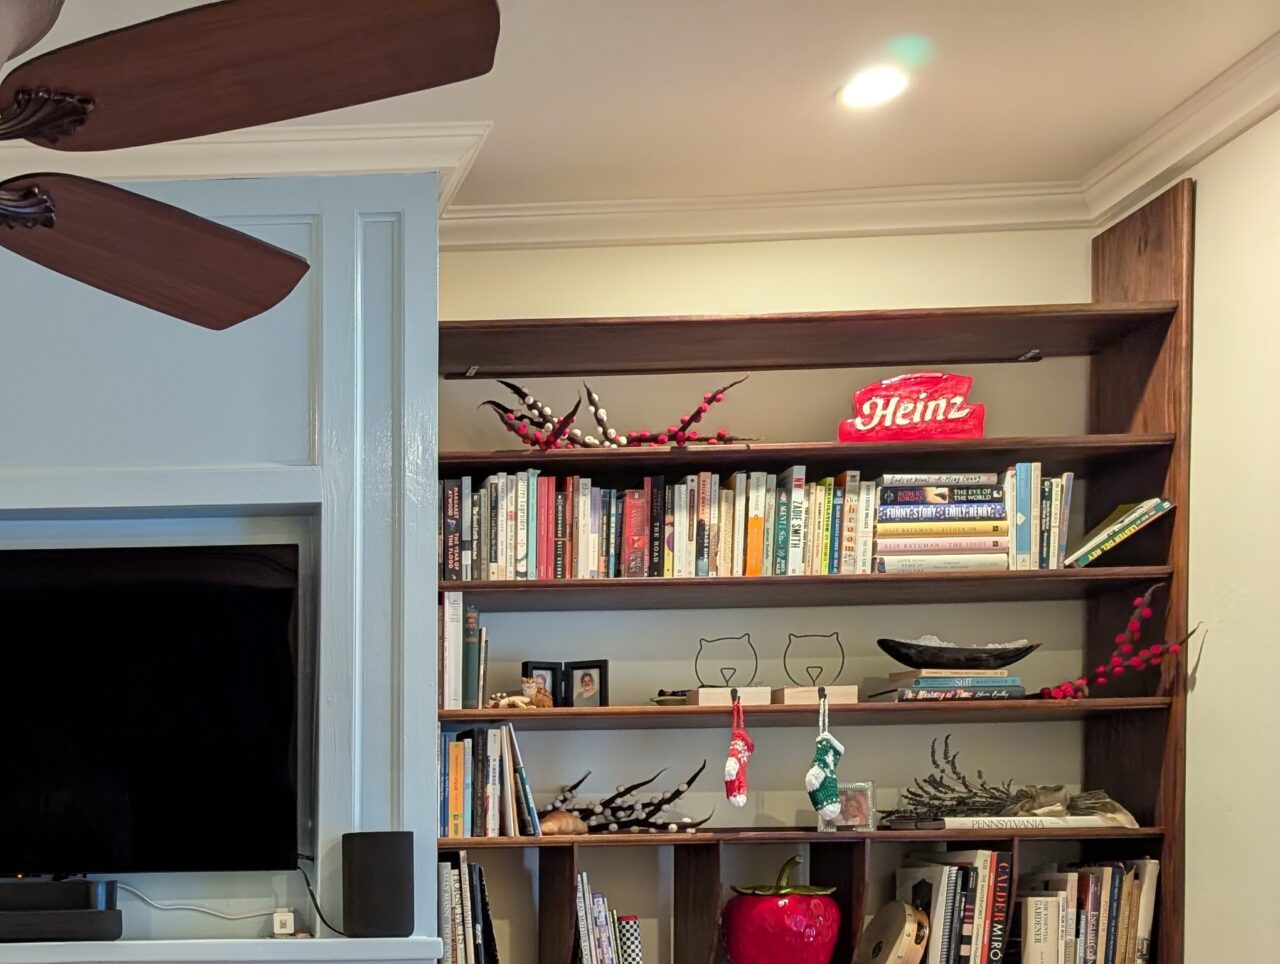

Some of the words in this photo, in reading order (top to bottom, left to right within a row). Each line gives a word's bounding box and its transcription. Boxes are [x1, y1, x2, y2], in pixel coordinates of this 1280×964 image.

[853, 392, 971, 431] Heinz
[794, 477, 803, 489] NW
[792, 500, 803, 520] ZADIE
[886, 508, 910, 518] FUNNY
[912, 508, 936, 518] STORY
[945, 507, 966, 518] EMILY
[968, 507, 992, 518] HENRY
[791, 524, 802, 549] SMITH
[1113, 524, 1138, 542] LESTER
[1087, 549, 1102, 560] REY
[1099, 540, 1116, 550] DEL
[454, 562, 460, 571] OF
[954, 678, 972, 687] Stiff
[902, 690, 916, 700] The
[916, 690, 945, 700] Ministry
[946, 690, 954, 698] of
[955, 690, 974, 698] Time
[972, 819, 1046, 829] PENNSYLVANIA
[453, 873, 462, 908] HORSE
[993, 862, 1009, 922] CALDER
[977, 884, 986, 920] MASTERWORKS
[455, 911, 464, 946] FACTS
[579, 915, 587, 944] MOTHER
[1034, 900, 1042, 944] GARDENER
[1090, 911, 1099, 943] ENGLISH
[990, 923, 1004, 961] MIRÓ
